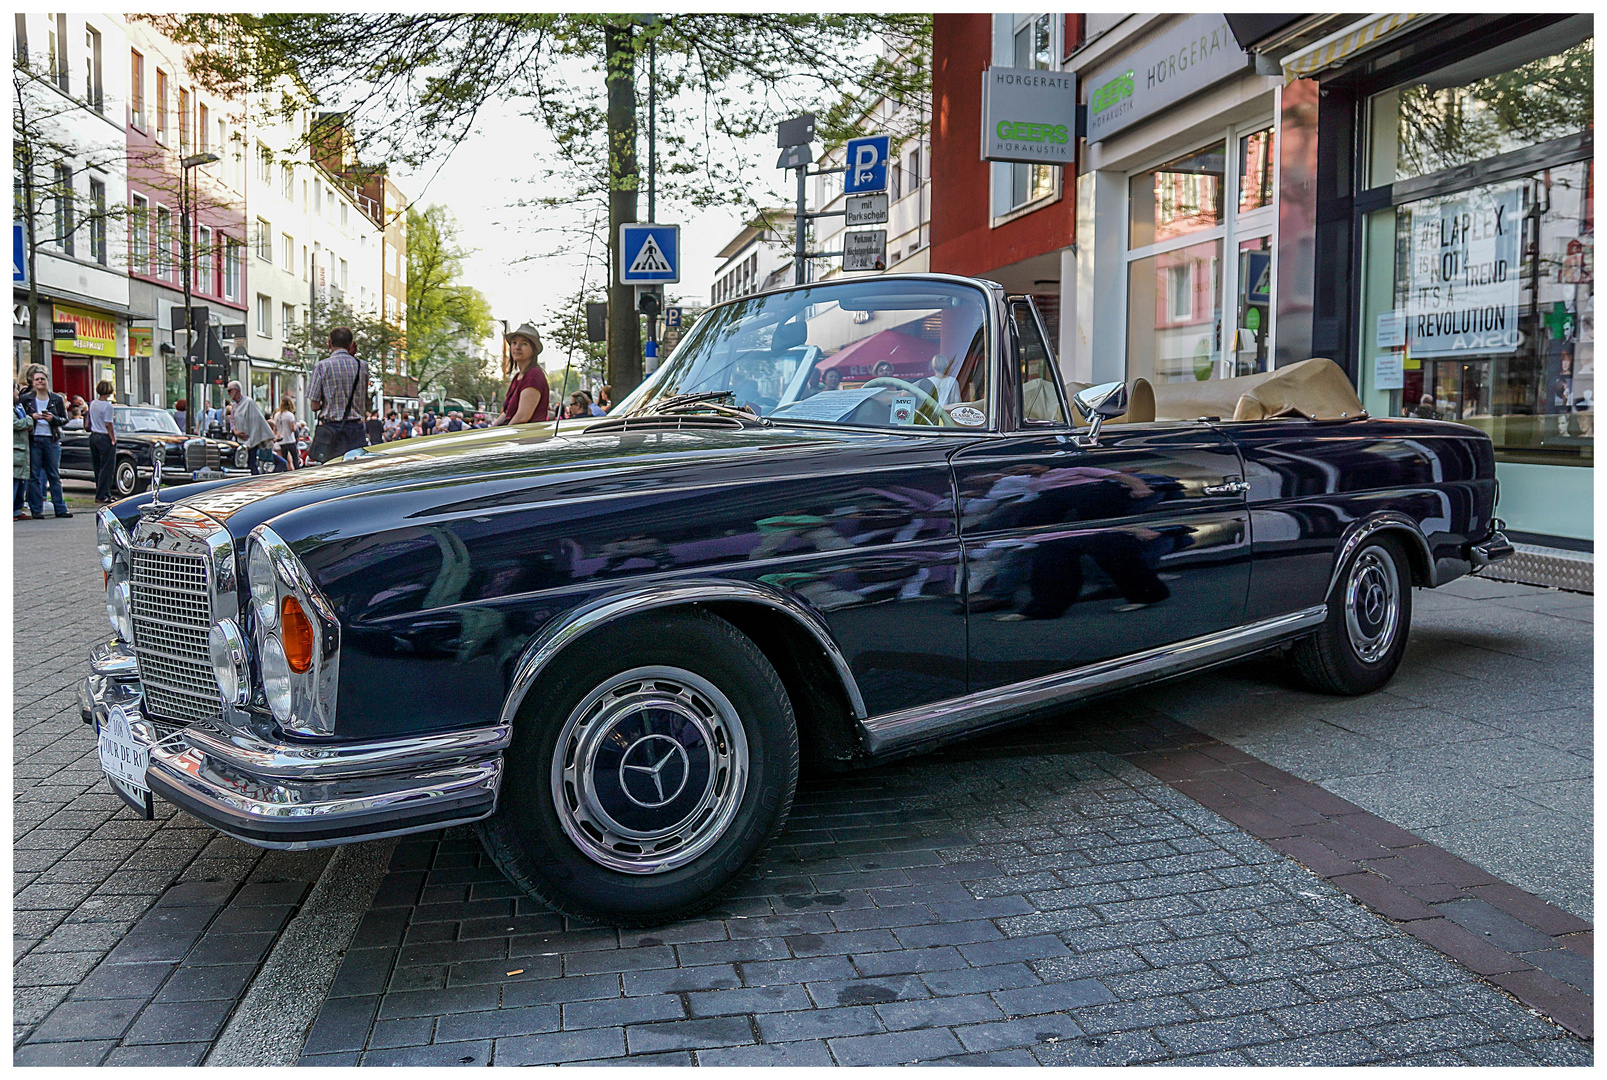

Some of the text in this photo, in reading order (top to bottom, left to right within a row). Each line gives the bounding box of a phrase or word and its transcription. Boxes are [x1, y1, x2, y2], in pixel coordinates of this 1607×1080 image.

[997, 73, 1069, 89] HÖRGERÄTE
[1092, 69, 1135, 114] GEERS
[1092, 100, 1134, 128] HÖRAKUSTIK
[996, 120, 1068, 144] GEERS
[997, 142, 1067, 155] HÖRAKUSTIK
[854, 144, 879, 186] P
[848, 209, 886, 221] Parkschein
[861, 199, 873, 210] mit
[1419, 248, 1508, 287] IS NOT A TREND
[1418, 284, 1454, 310] IT'S A
[668, 309, 679, 325] P
[1417, 303, 1506, 338] REVOLUTION
[102, 735, 120, 759] TOUR
[120, 744, 131, 764] DE
